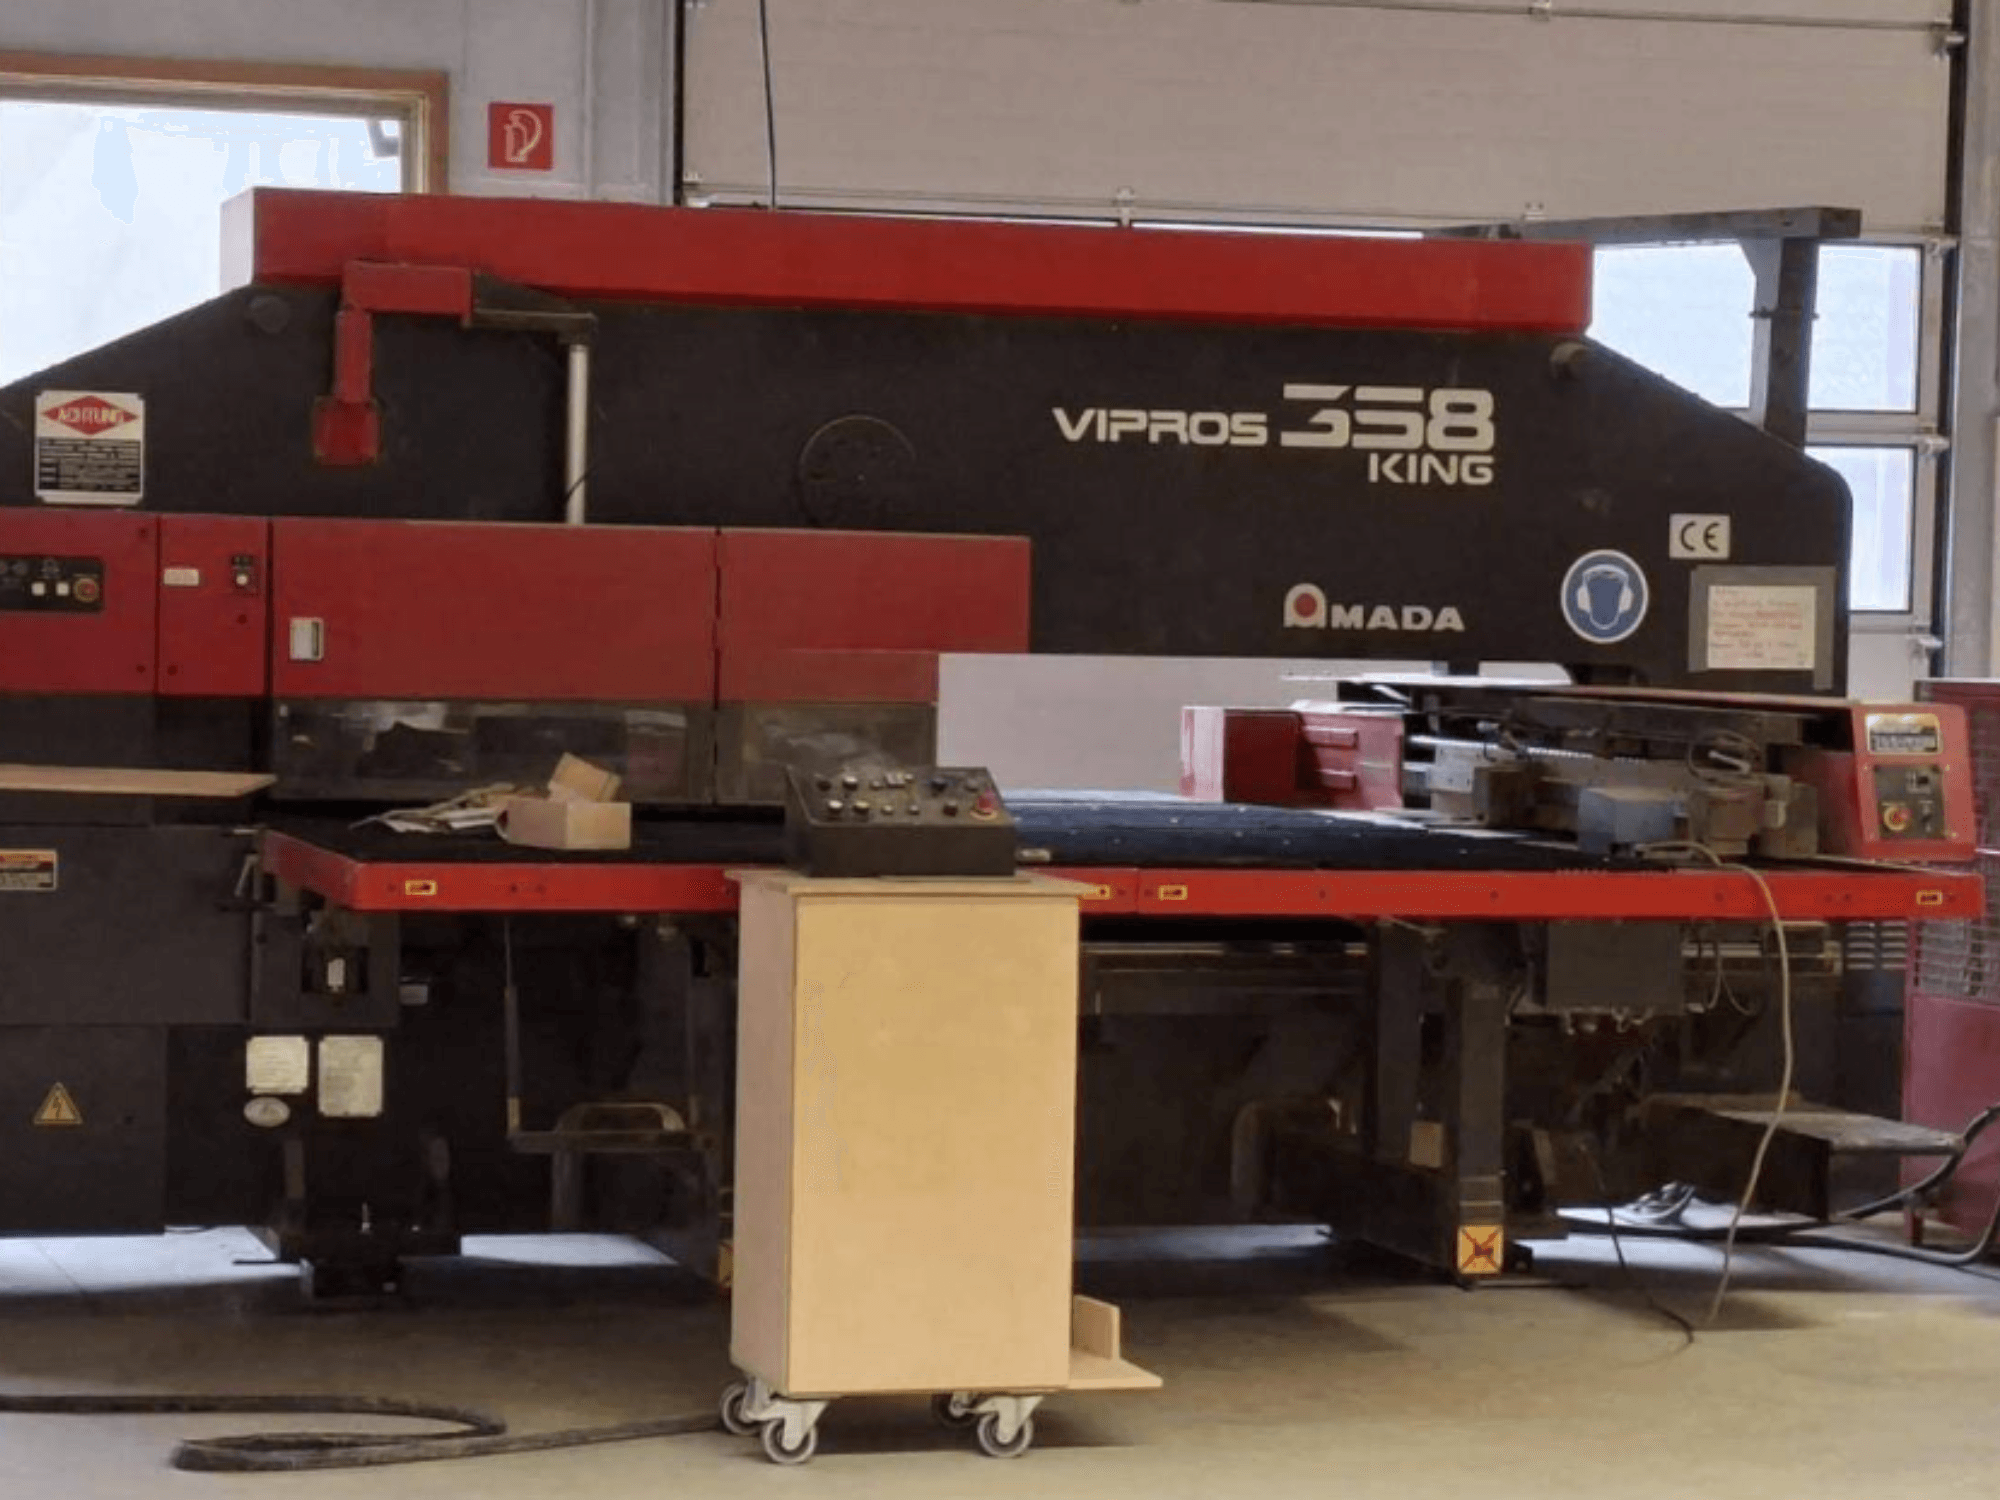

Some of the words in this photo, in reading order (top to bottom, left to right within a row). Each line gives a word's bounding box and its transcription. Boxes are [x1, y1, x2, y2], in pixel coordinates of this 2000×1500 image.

[1052, 407, 1268, 445] VIPROS
[1280, 383, 1495, 451] 358
[1368, 453, 1495, 485] KING
[1679, 521, 1721, 551] CE
[1283, 582, 1465, 631] AMADA
